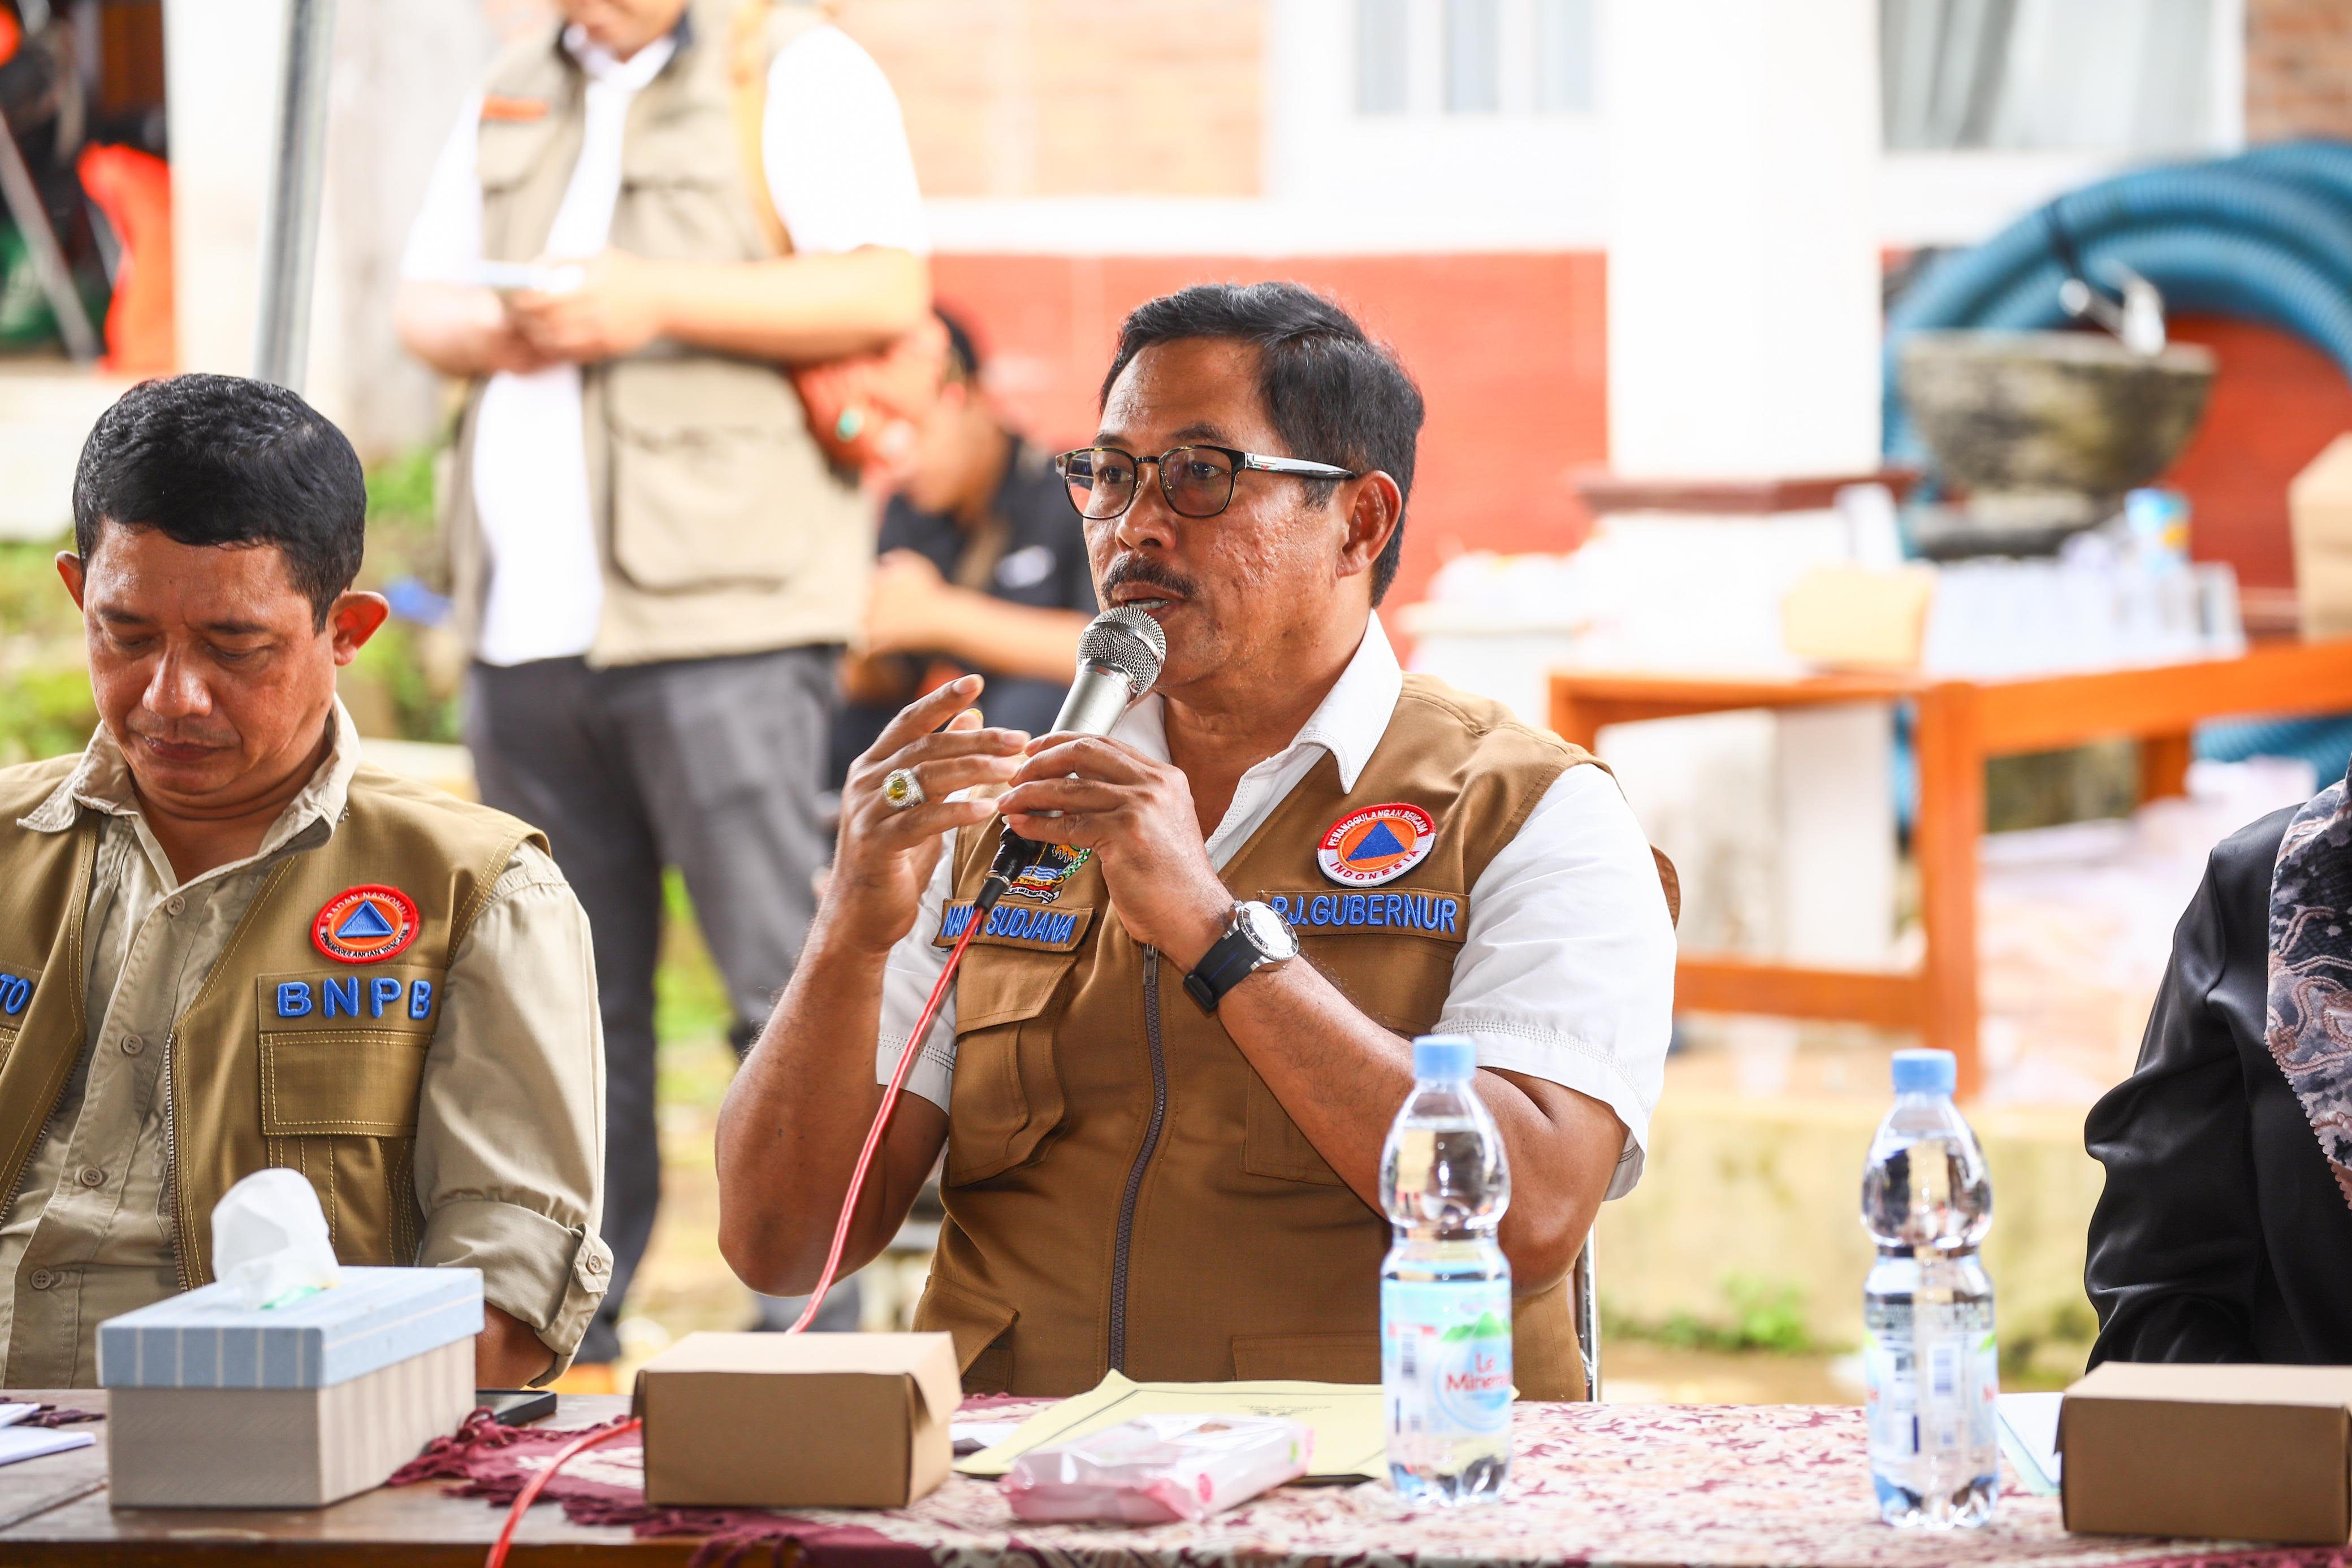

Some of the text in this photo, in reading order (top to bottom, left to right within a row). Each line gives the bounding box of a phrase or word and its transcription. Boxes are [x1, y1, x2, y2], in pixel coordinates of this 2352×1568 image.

[1327, 809, 1403, 846] PENANGGULANGAN
[1330, 849, 1420, 880] INDONESIA
[326, 891, 408, 919] BADAN NASIONAL
[941, 905, 1077, 943] NAN SUDJANA
[0, 972, 31, 1015] TO
[277, 976, 433, 1020] BNPB
[1475, 1352, 1494, 1374] Le
